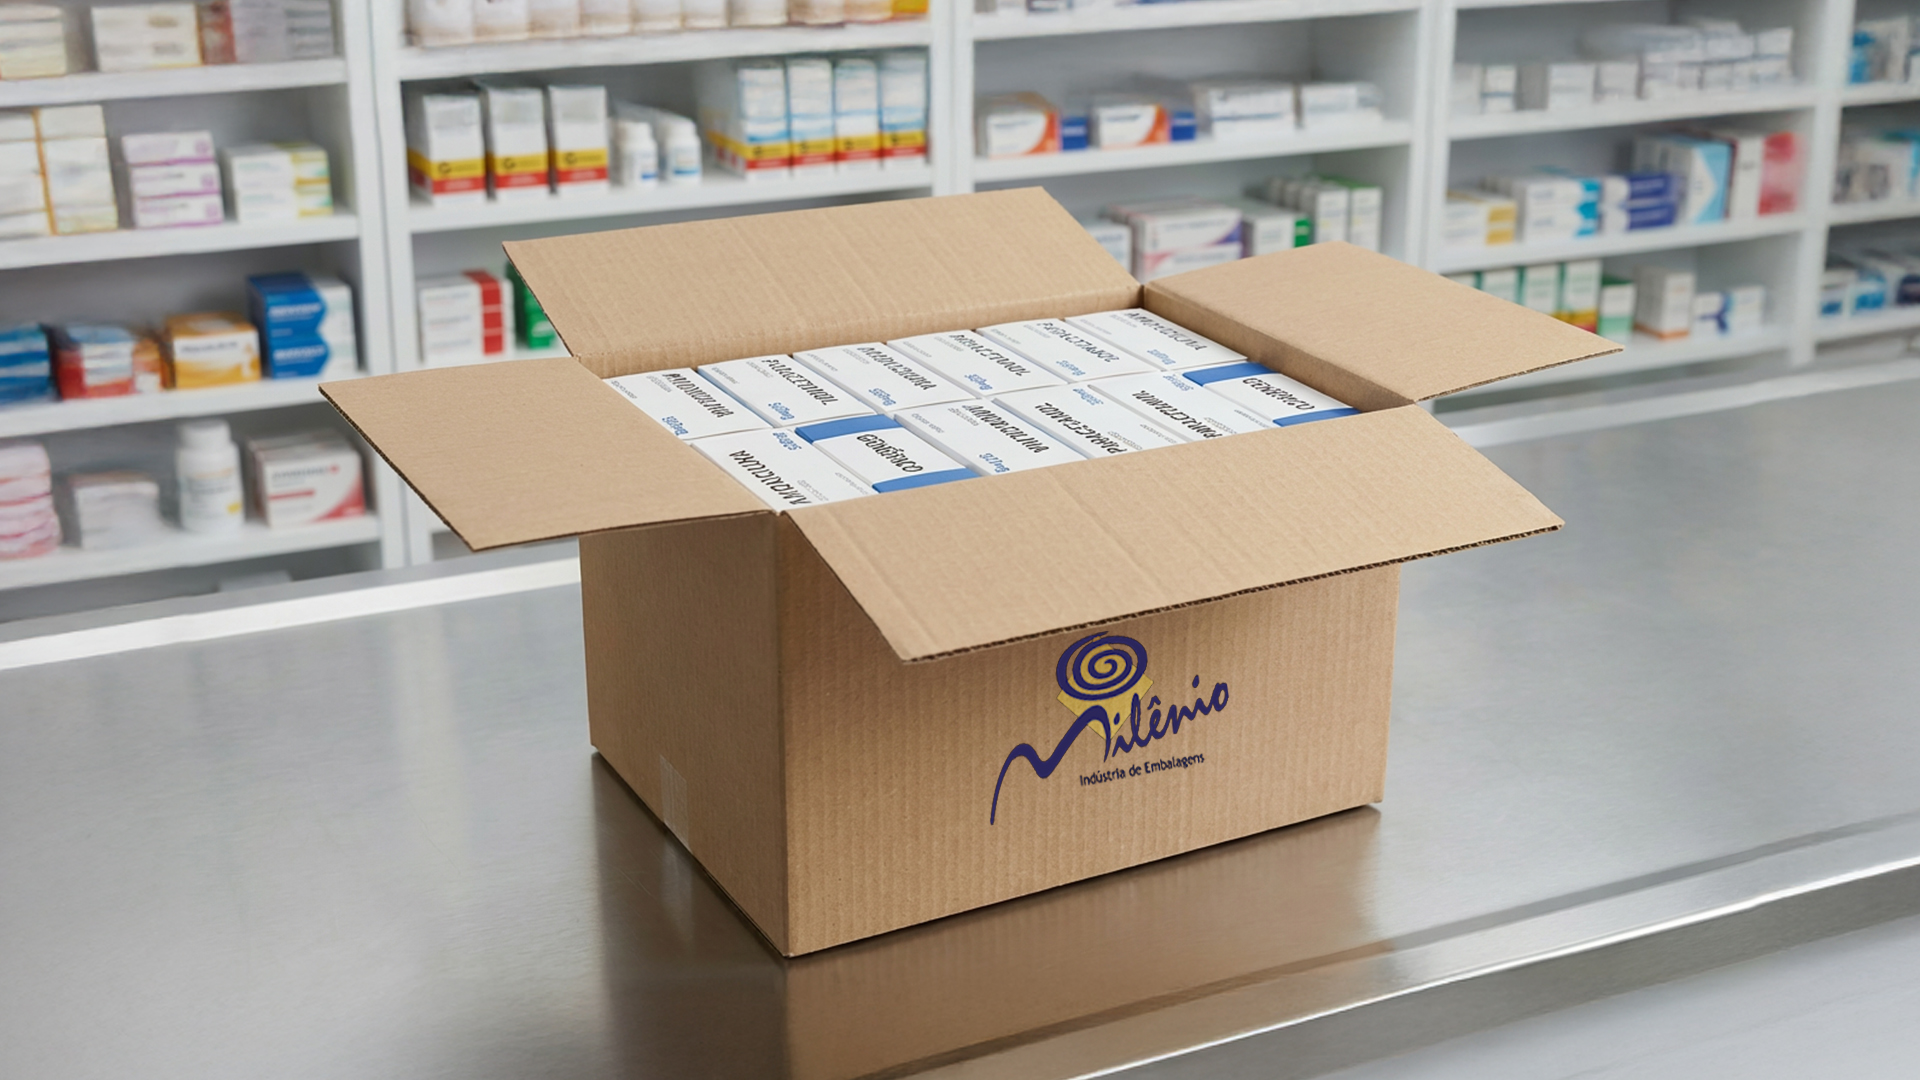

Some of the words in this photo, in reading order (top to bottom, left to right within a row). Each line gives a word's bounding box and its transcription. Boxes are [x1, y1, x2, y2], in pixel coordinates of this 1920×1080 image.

[990, 674, 1230, 825] Milênio
[1080, 767, 1126, 786] Indústria
[1128, 763, 1142, 777] de
[1144, 752, 1205, 774] Embalagens
